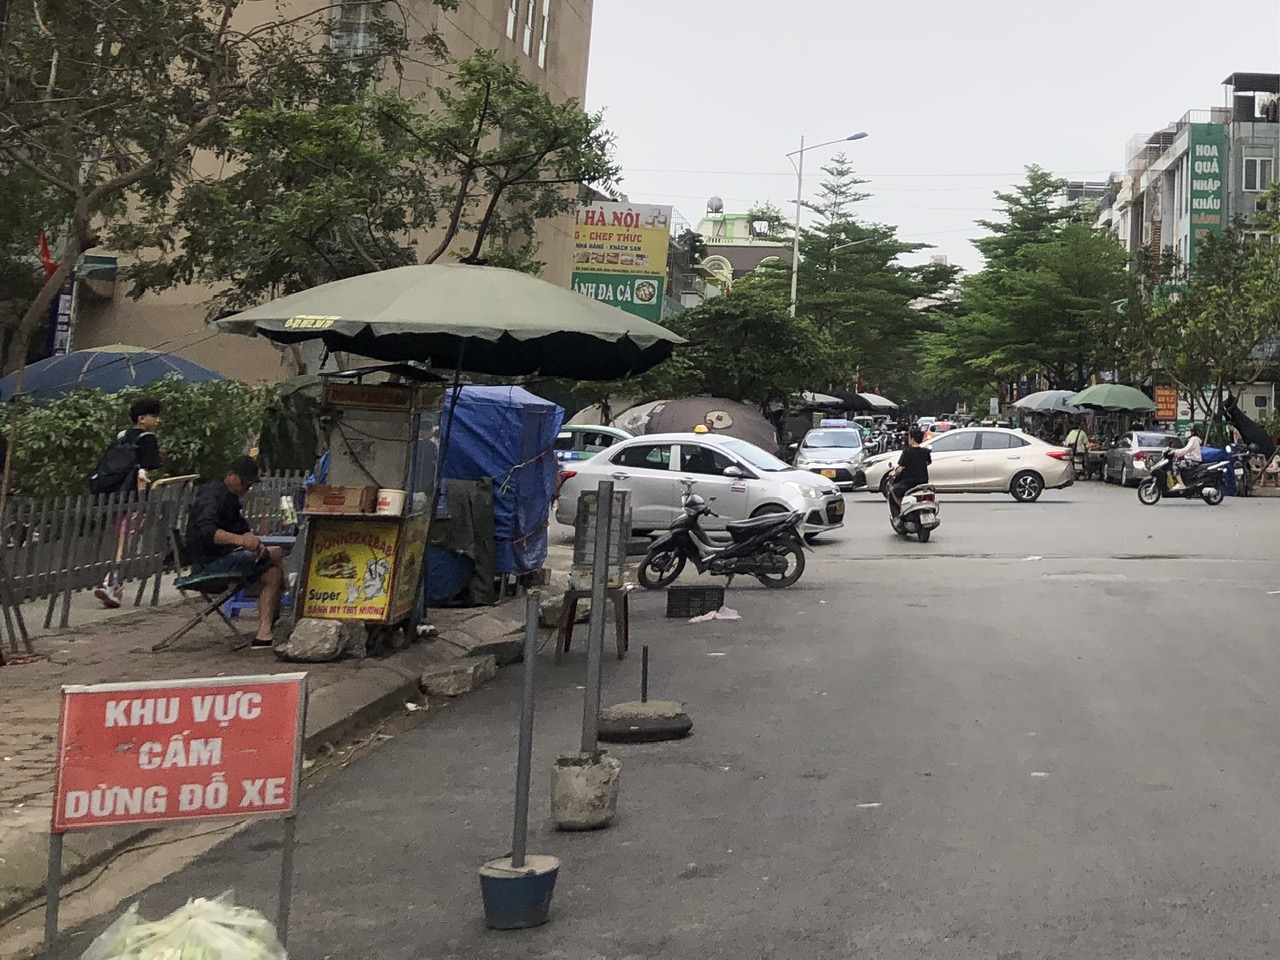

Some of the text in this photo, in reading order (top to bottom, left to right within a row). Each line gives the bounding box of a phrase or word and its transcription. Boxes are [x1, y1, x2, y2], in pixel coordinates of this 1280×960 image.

[1195, 144, 1219, 157] HOA
[1194, 158, 1219, 174] QUẢ
[1192, 178, 1221, 193] NHẬP
[583, 206, 606, 227] HÀ
[611, 208, 641, 232] NỘI
[589, 231, 614, 241] CHEF
[574, 278, 631, 301] ÁNH ĐA CÁ
[308, 588, 342, 603] Super
[105, 691, 263, 728] KHU VỰC
[138, 729, 223, 770] CẤM
[64, 771, 286, 819] DỪNG ĐỖ XE
